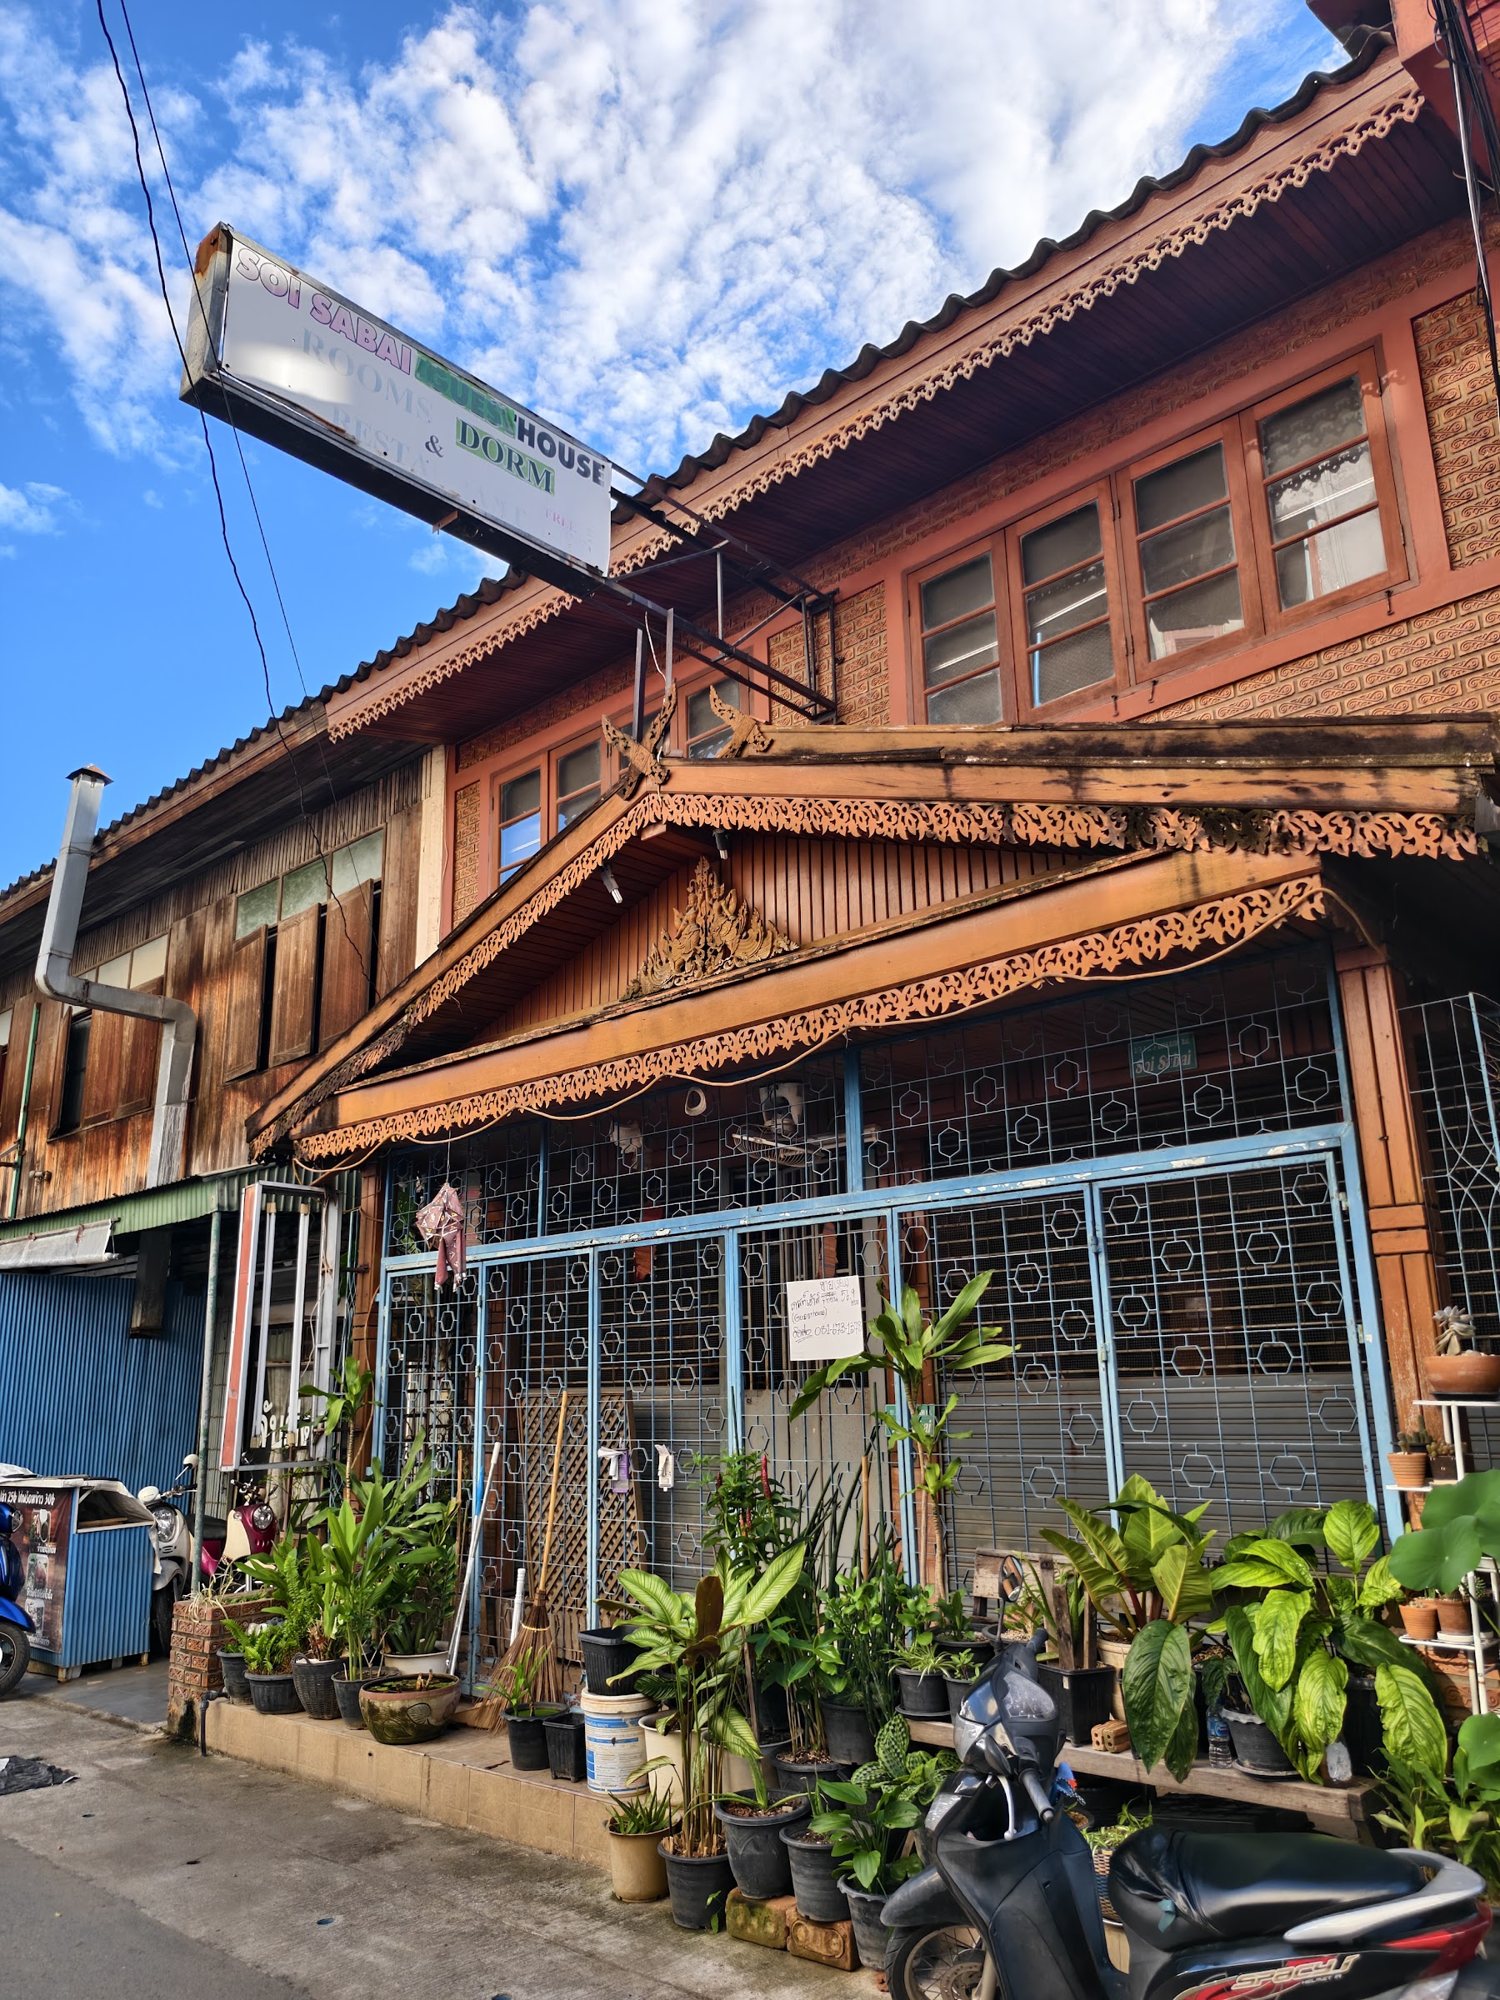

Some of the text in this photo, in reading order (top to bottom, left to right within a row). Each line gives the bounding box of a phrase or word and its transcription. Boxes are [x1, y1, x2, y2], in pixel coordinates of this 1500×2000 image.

[236, 247, 301, 309] SOI
[310, 293, 411, 375] SABAI
[518, 416, 606, 488] HOUSE
[302, 328, 555, 495] ROOMS DORM
[424, 434, 444, 458] &
